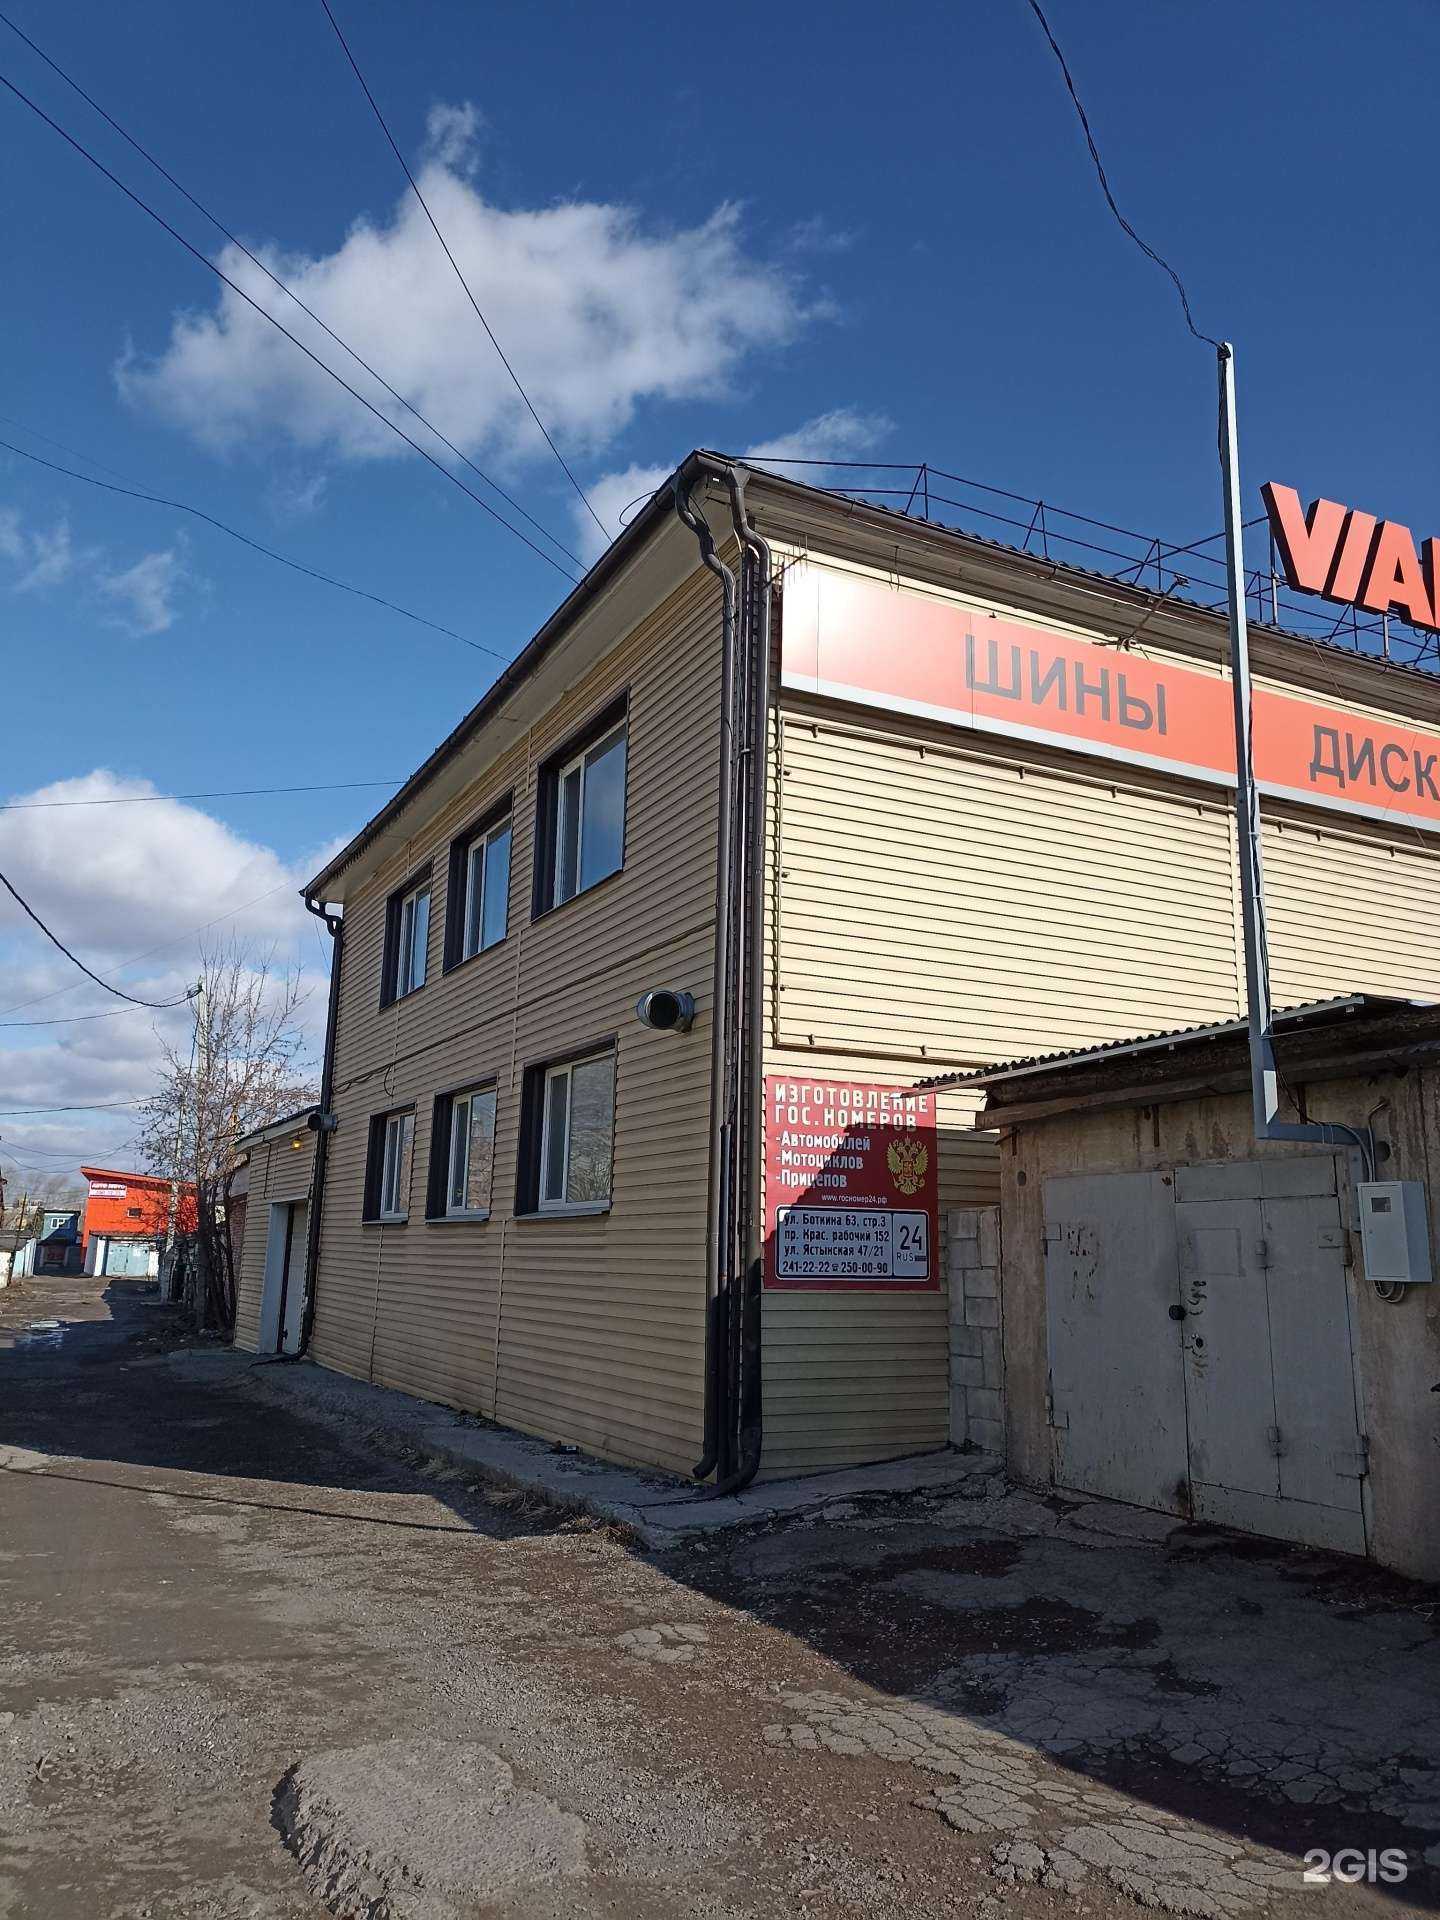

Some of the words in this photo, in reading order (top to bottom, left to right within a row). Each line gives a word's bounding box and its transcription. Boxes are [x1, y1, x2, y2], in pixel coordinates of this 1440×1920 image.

[1261, 481, 1440, 634] VIA
[965, 633, 1167, 736] ШИНЫ
[775, 1083, 928, 1113] ИЗГОТОВЛЕНИЕ
[775, 1104, 820, 1126] ГОС.
[823, 1107, 918, 1132] НОМЕРОВ
[821, 1193, 888, 1204] www.госномер24.рф
[784, 1214, 799, 1226] ул.
[802, 1214, 842, 1226] Боткина
[784, 1230, 799, 1242] пр.
[802, 1229, 828, 1241] Крас.
[832, 1229, 871, 1242] рабочий
[874, 1230, 890, 1242] 152
[899, 1225, 923, 1251] 24
[784, 1245, 799, 1257] ул.
[803, 1244, 855, 1257] Ястынская
[857, 1245, 884, 1257] 47/21
[896, 1252, 914, 1262] RUS
[782, 1261, 830, 1273] 241-22-22
[841, 1262, 888, 1274] 250-00-90
